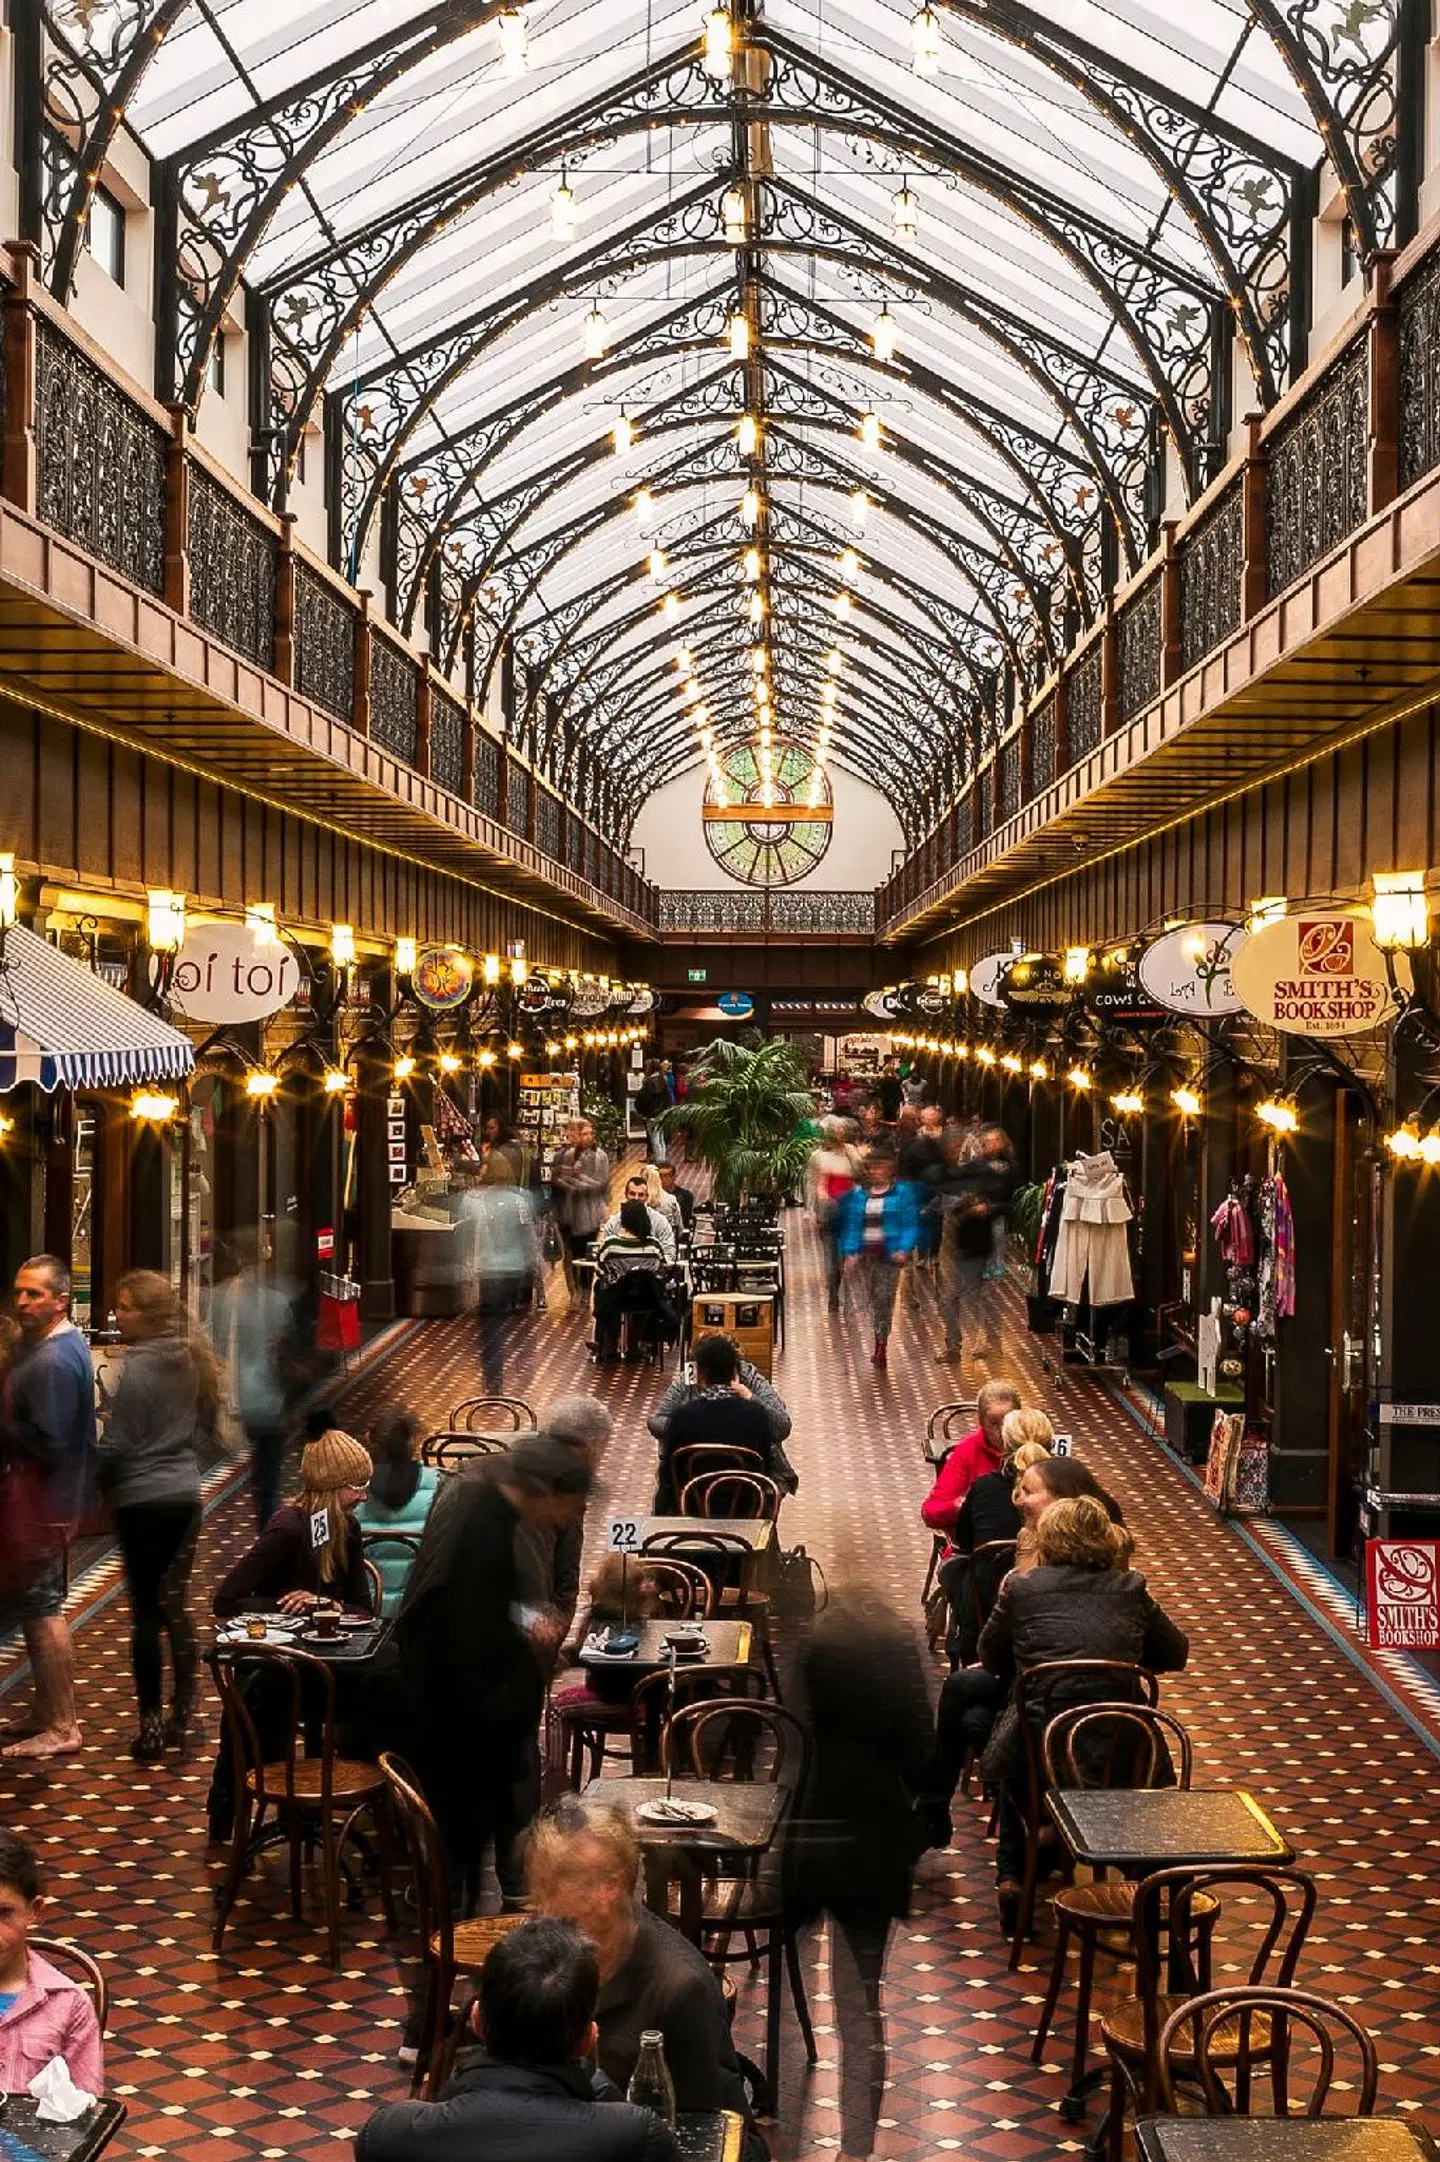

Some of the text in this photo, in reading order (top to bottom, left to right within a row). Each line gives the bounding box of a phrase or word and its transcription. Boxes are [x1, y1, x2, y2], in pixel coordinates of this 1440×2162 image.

[1273, 979, 1373, 1000] SMITH'S
[1094, 994, 1133, 1007] COWS
[1273, 1001, 1377, 1021] BOOKSHOP
[1392, 1406, 1415, 1417] THE
[313, 1514, 327, 1541] 25
[612, 1523, 637, 1546] 22
[1376, 1606, 1437, 1631] SMITH'S
[1378, 1630, 1439, 1646] BOOKSHOP
